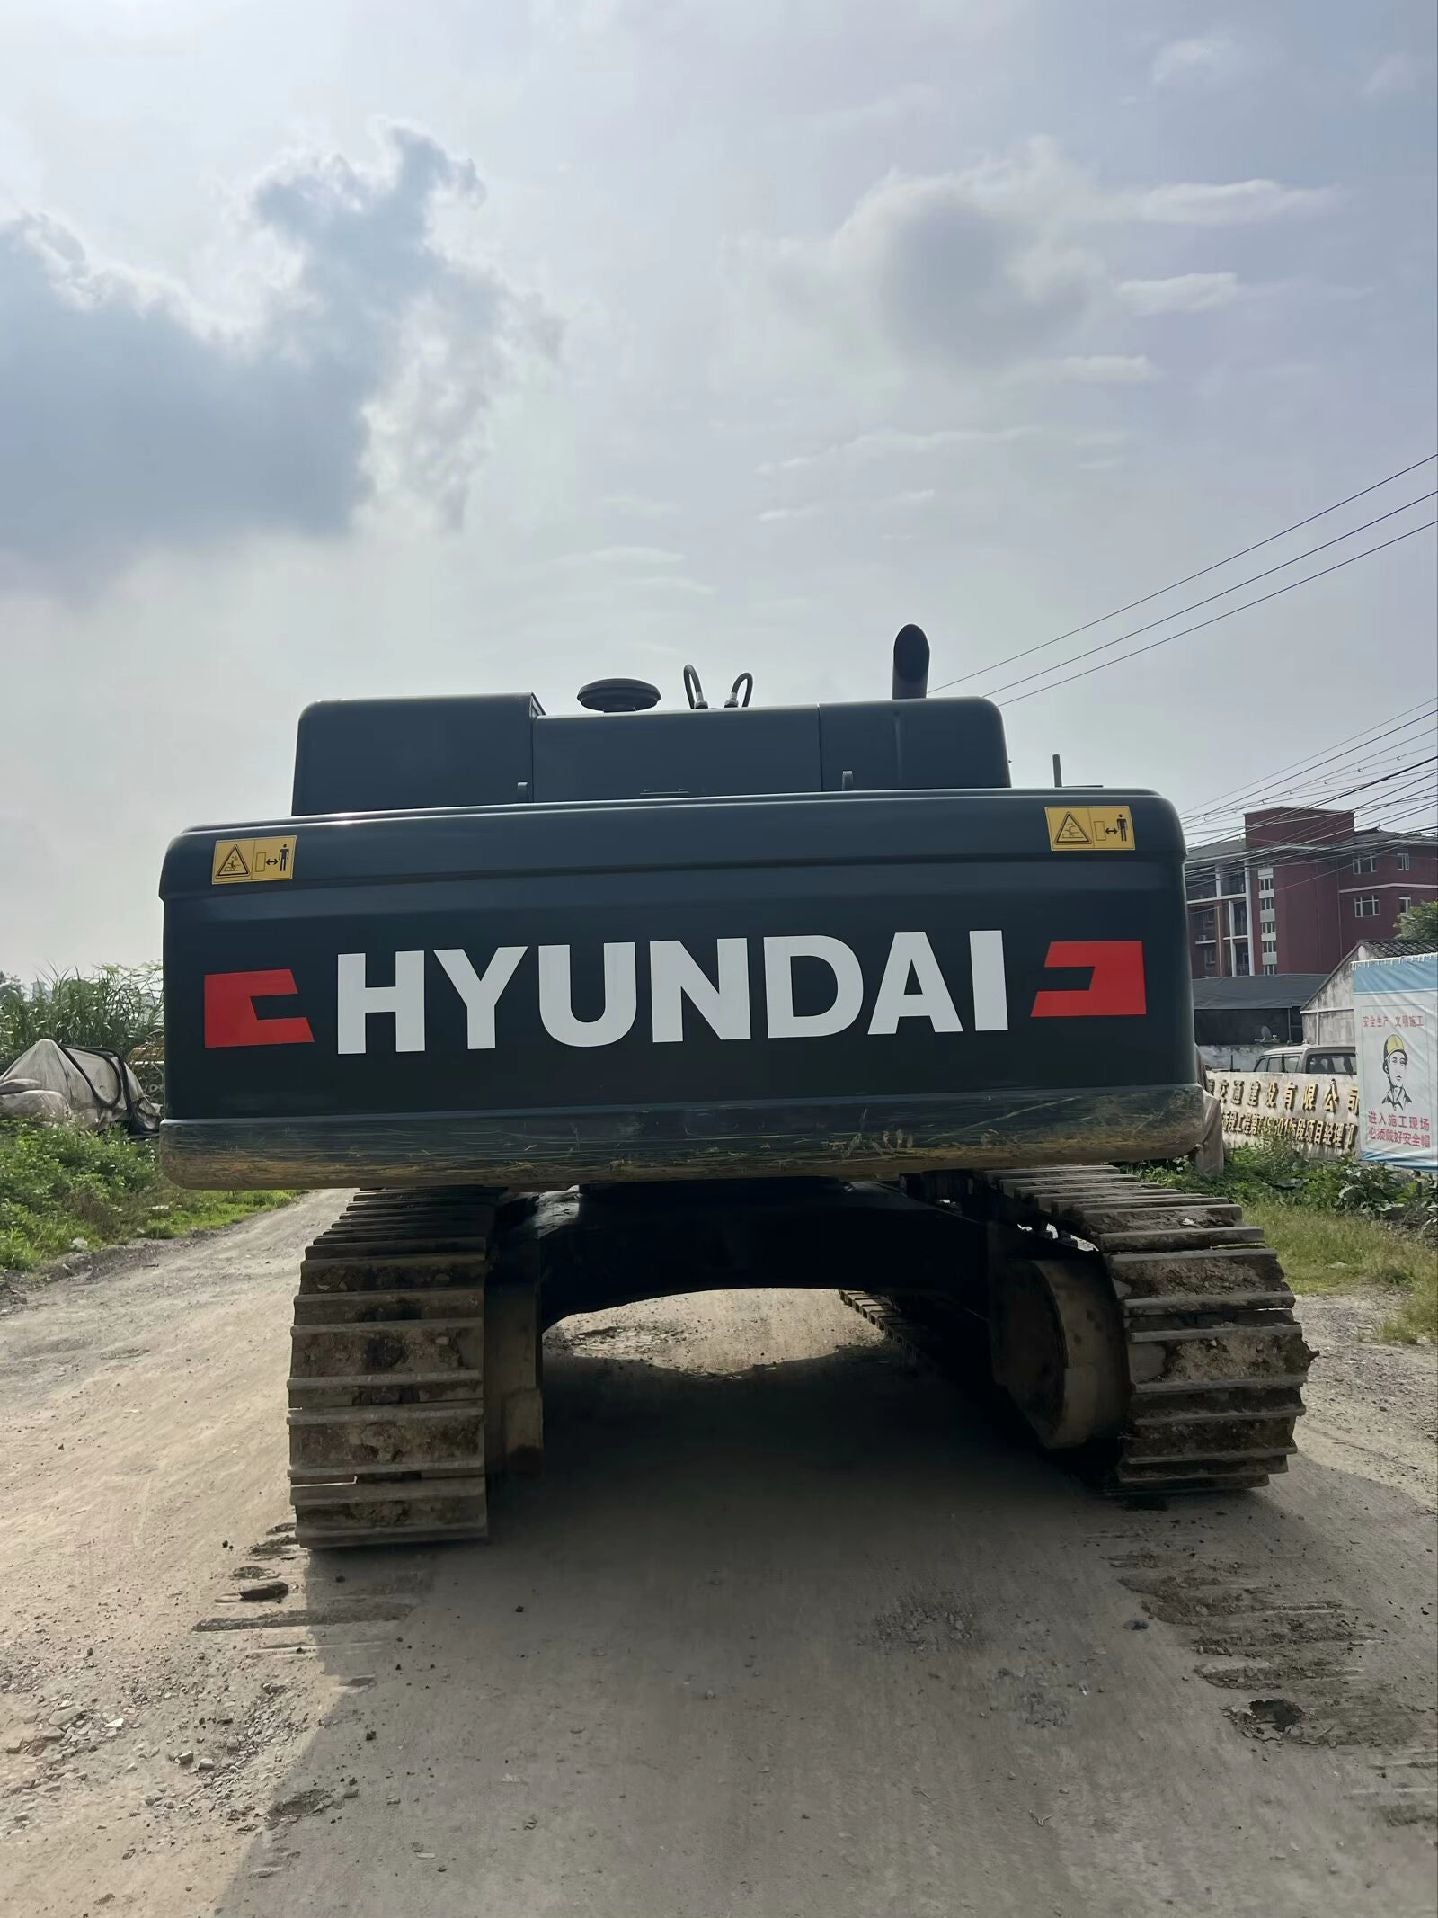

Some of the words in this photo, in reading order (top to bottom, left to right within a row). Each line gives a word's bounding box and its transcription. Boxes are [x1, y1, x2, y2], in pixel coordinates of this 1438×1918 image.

[337, 930, 1009, 1055] HYUNDAI
[1368, 1111, 1430, 1131] 进入施工现场
